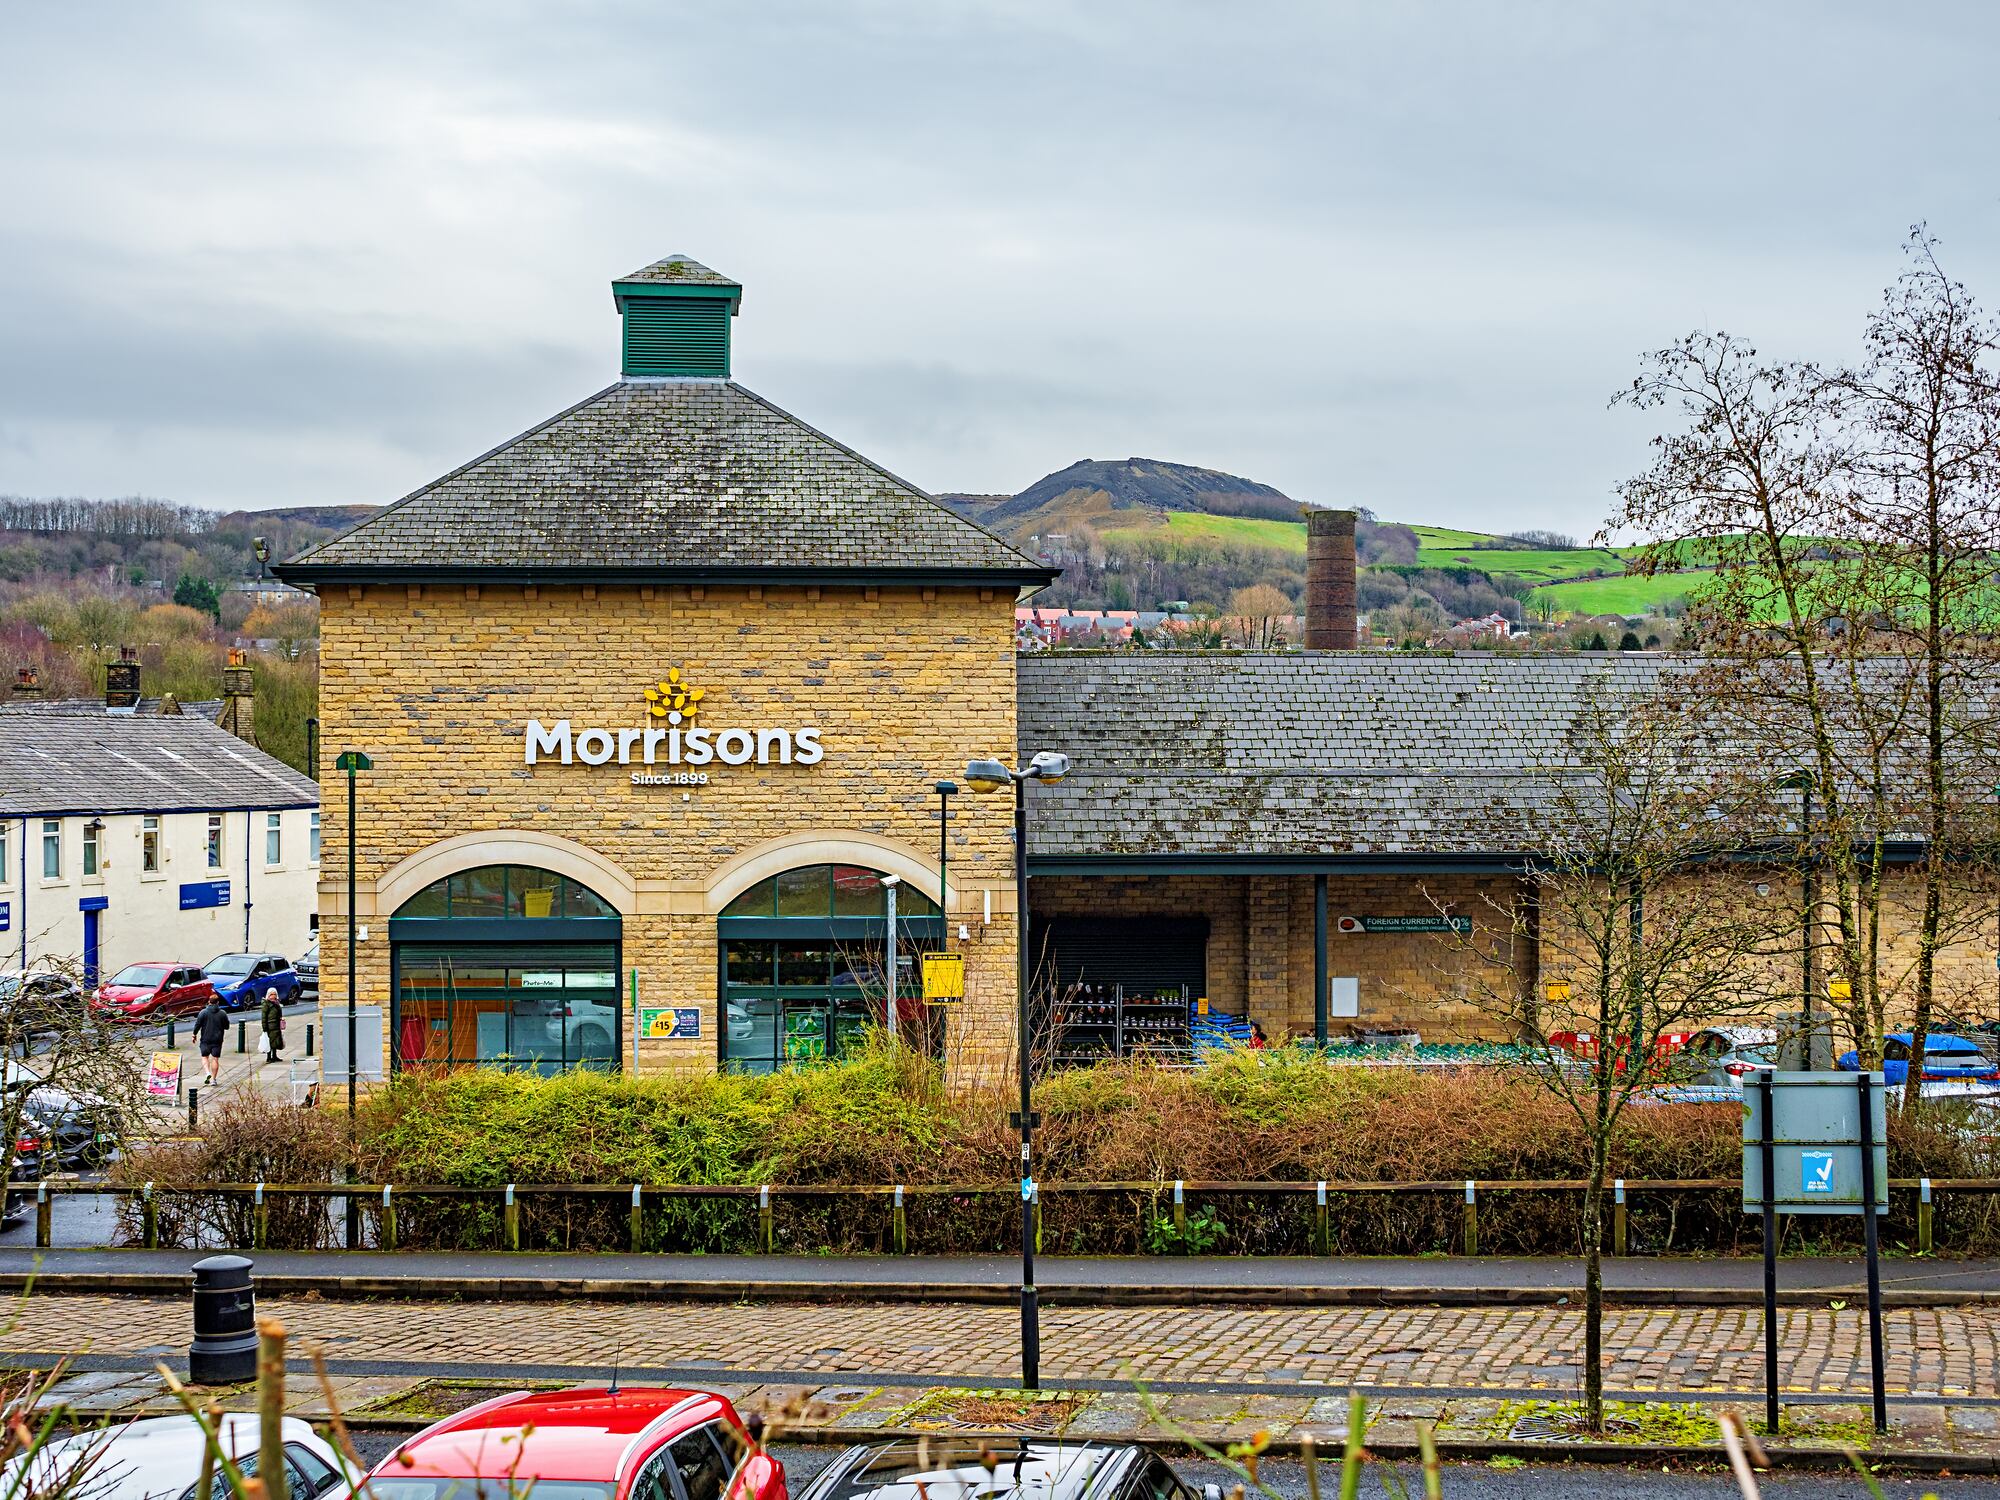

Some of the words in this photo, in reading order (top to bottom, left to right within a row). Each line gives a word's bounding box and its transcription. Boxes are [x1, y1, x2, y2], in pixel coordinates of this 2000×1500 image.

[525, 711, 824, 765] Morrisons
[631, 773, 671, 785] Since
[674, 773, 708, 785] 1899
[655, 1021, 670, 1030] £15
